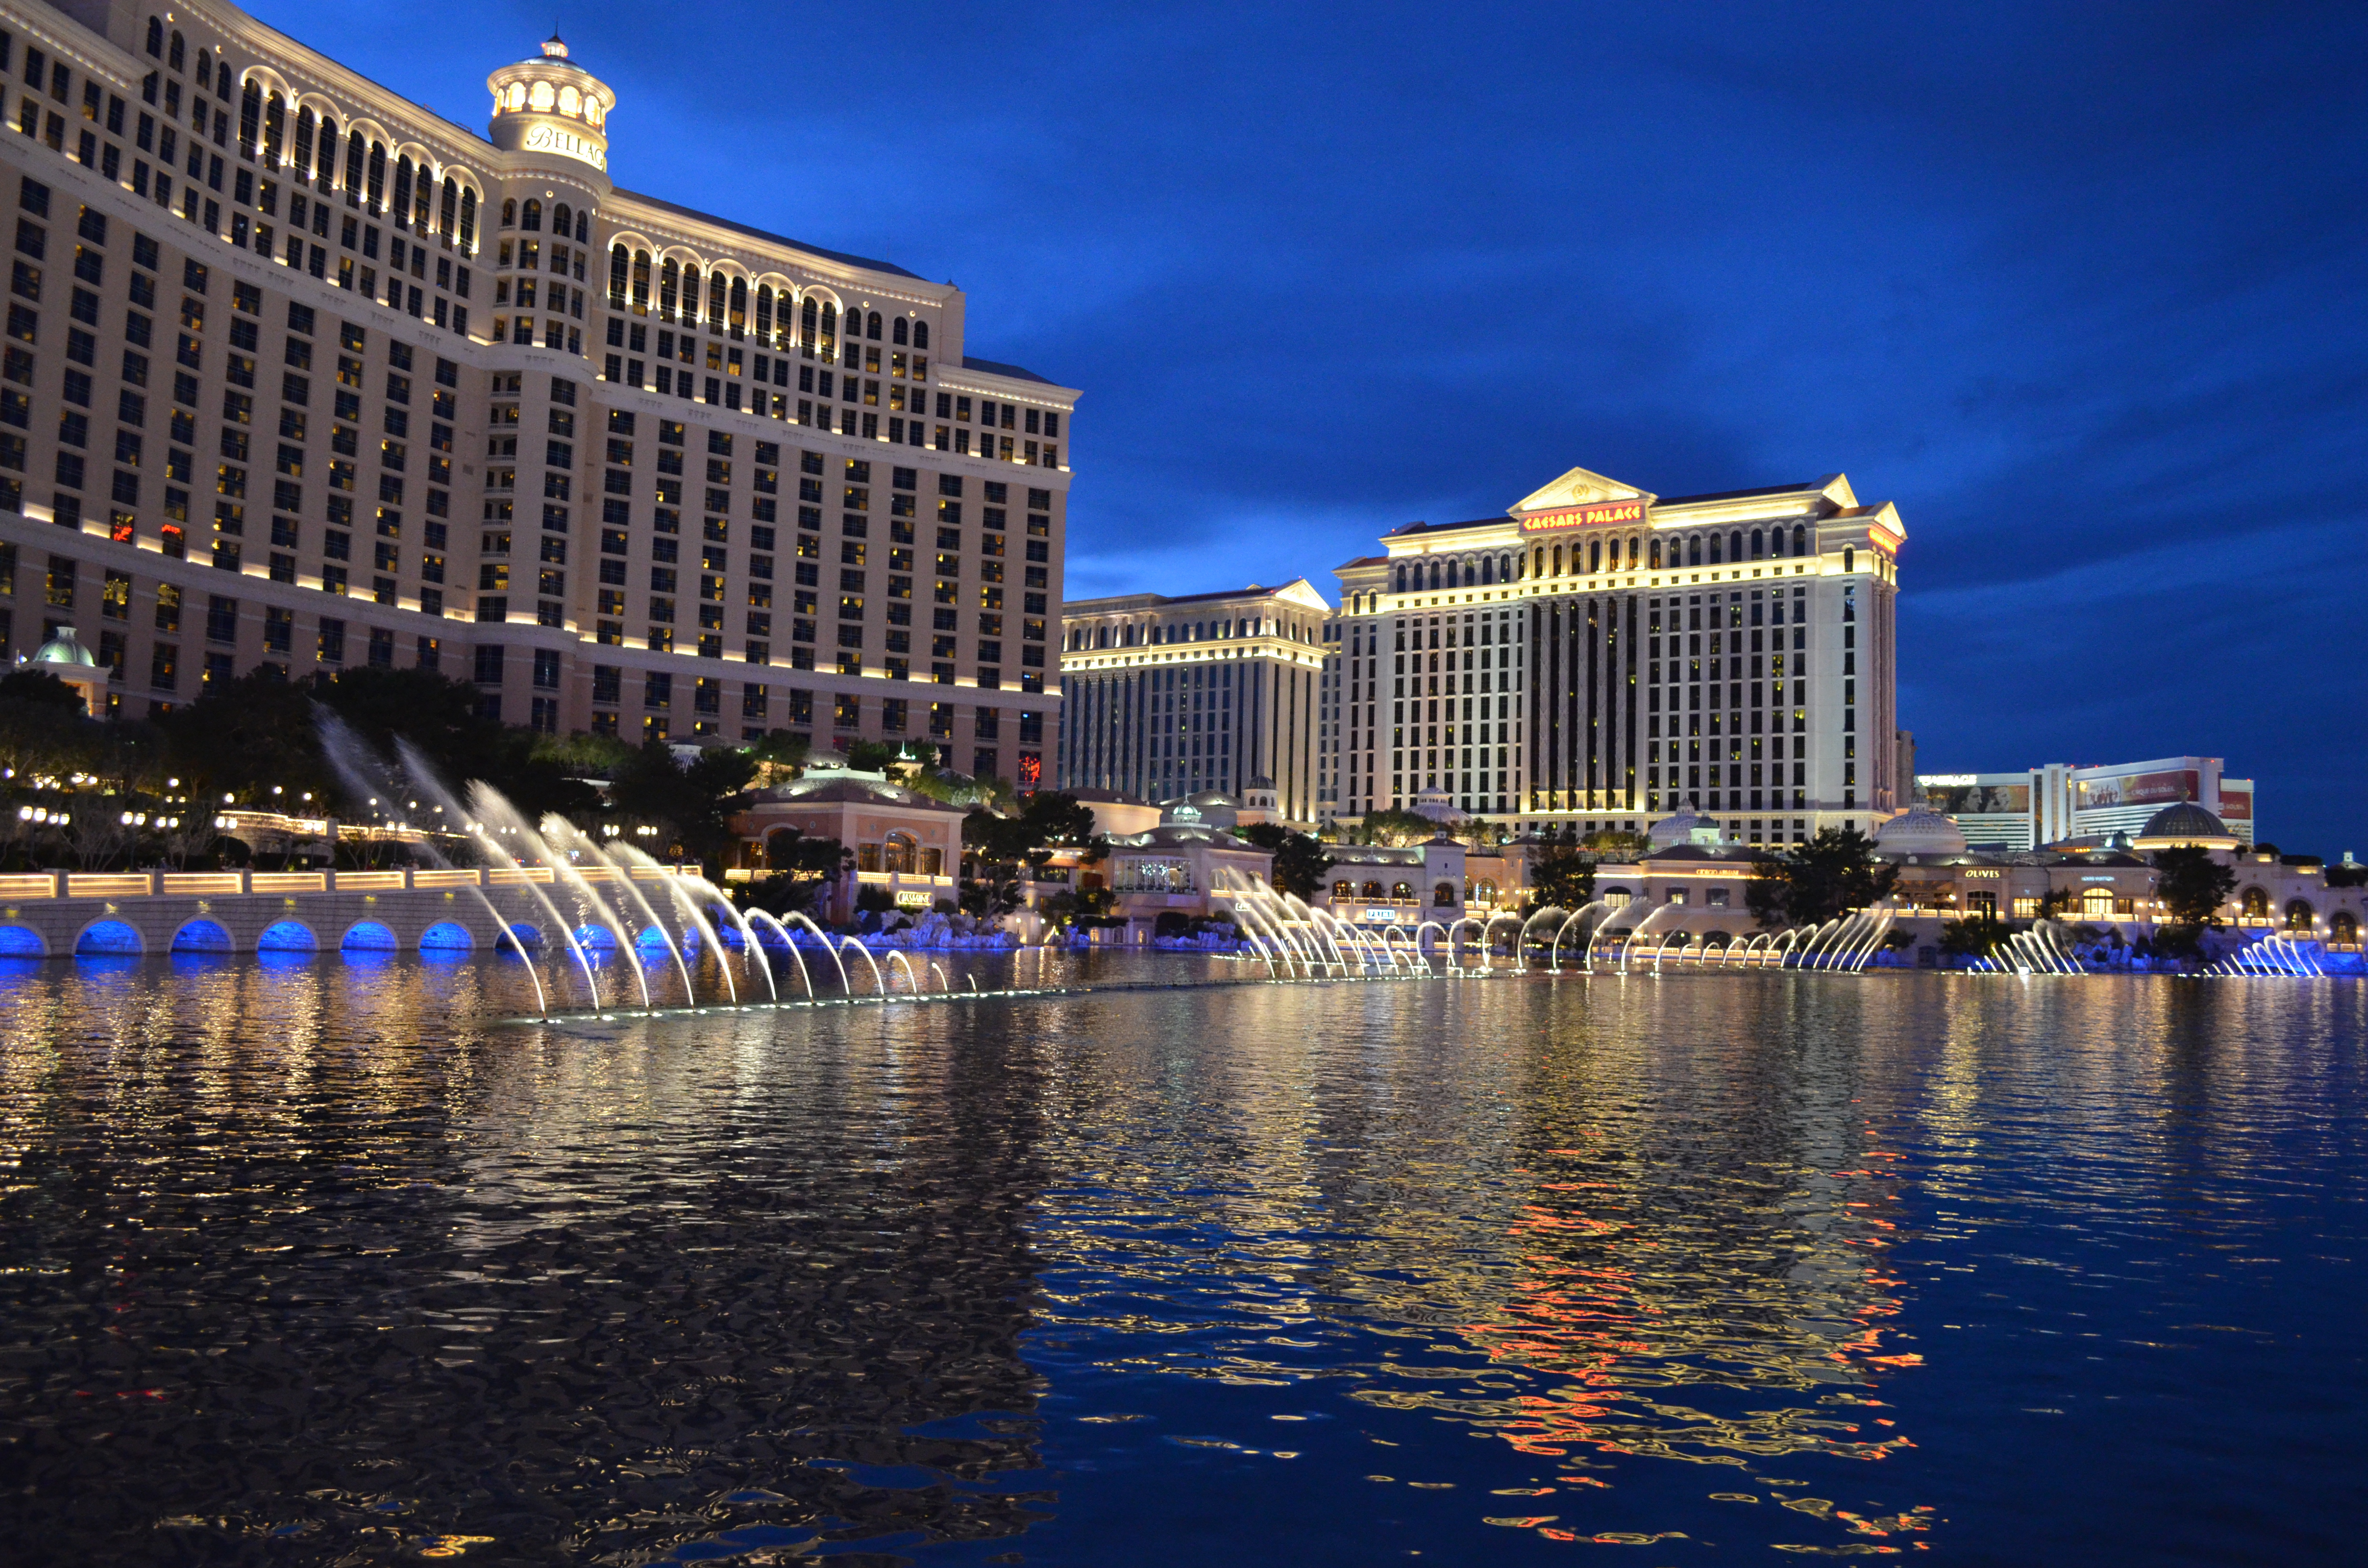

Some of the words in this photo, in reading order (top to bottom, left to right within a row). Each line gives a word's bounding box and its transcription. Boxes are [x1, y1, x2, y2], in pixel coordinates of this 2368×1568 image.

[1523, 512, 1582, 530] CAESARS
[1587, 505, 1640, 524] PALACE
[1922, 775, 1977, 786] MIRAGE
